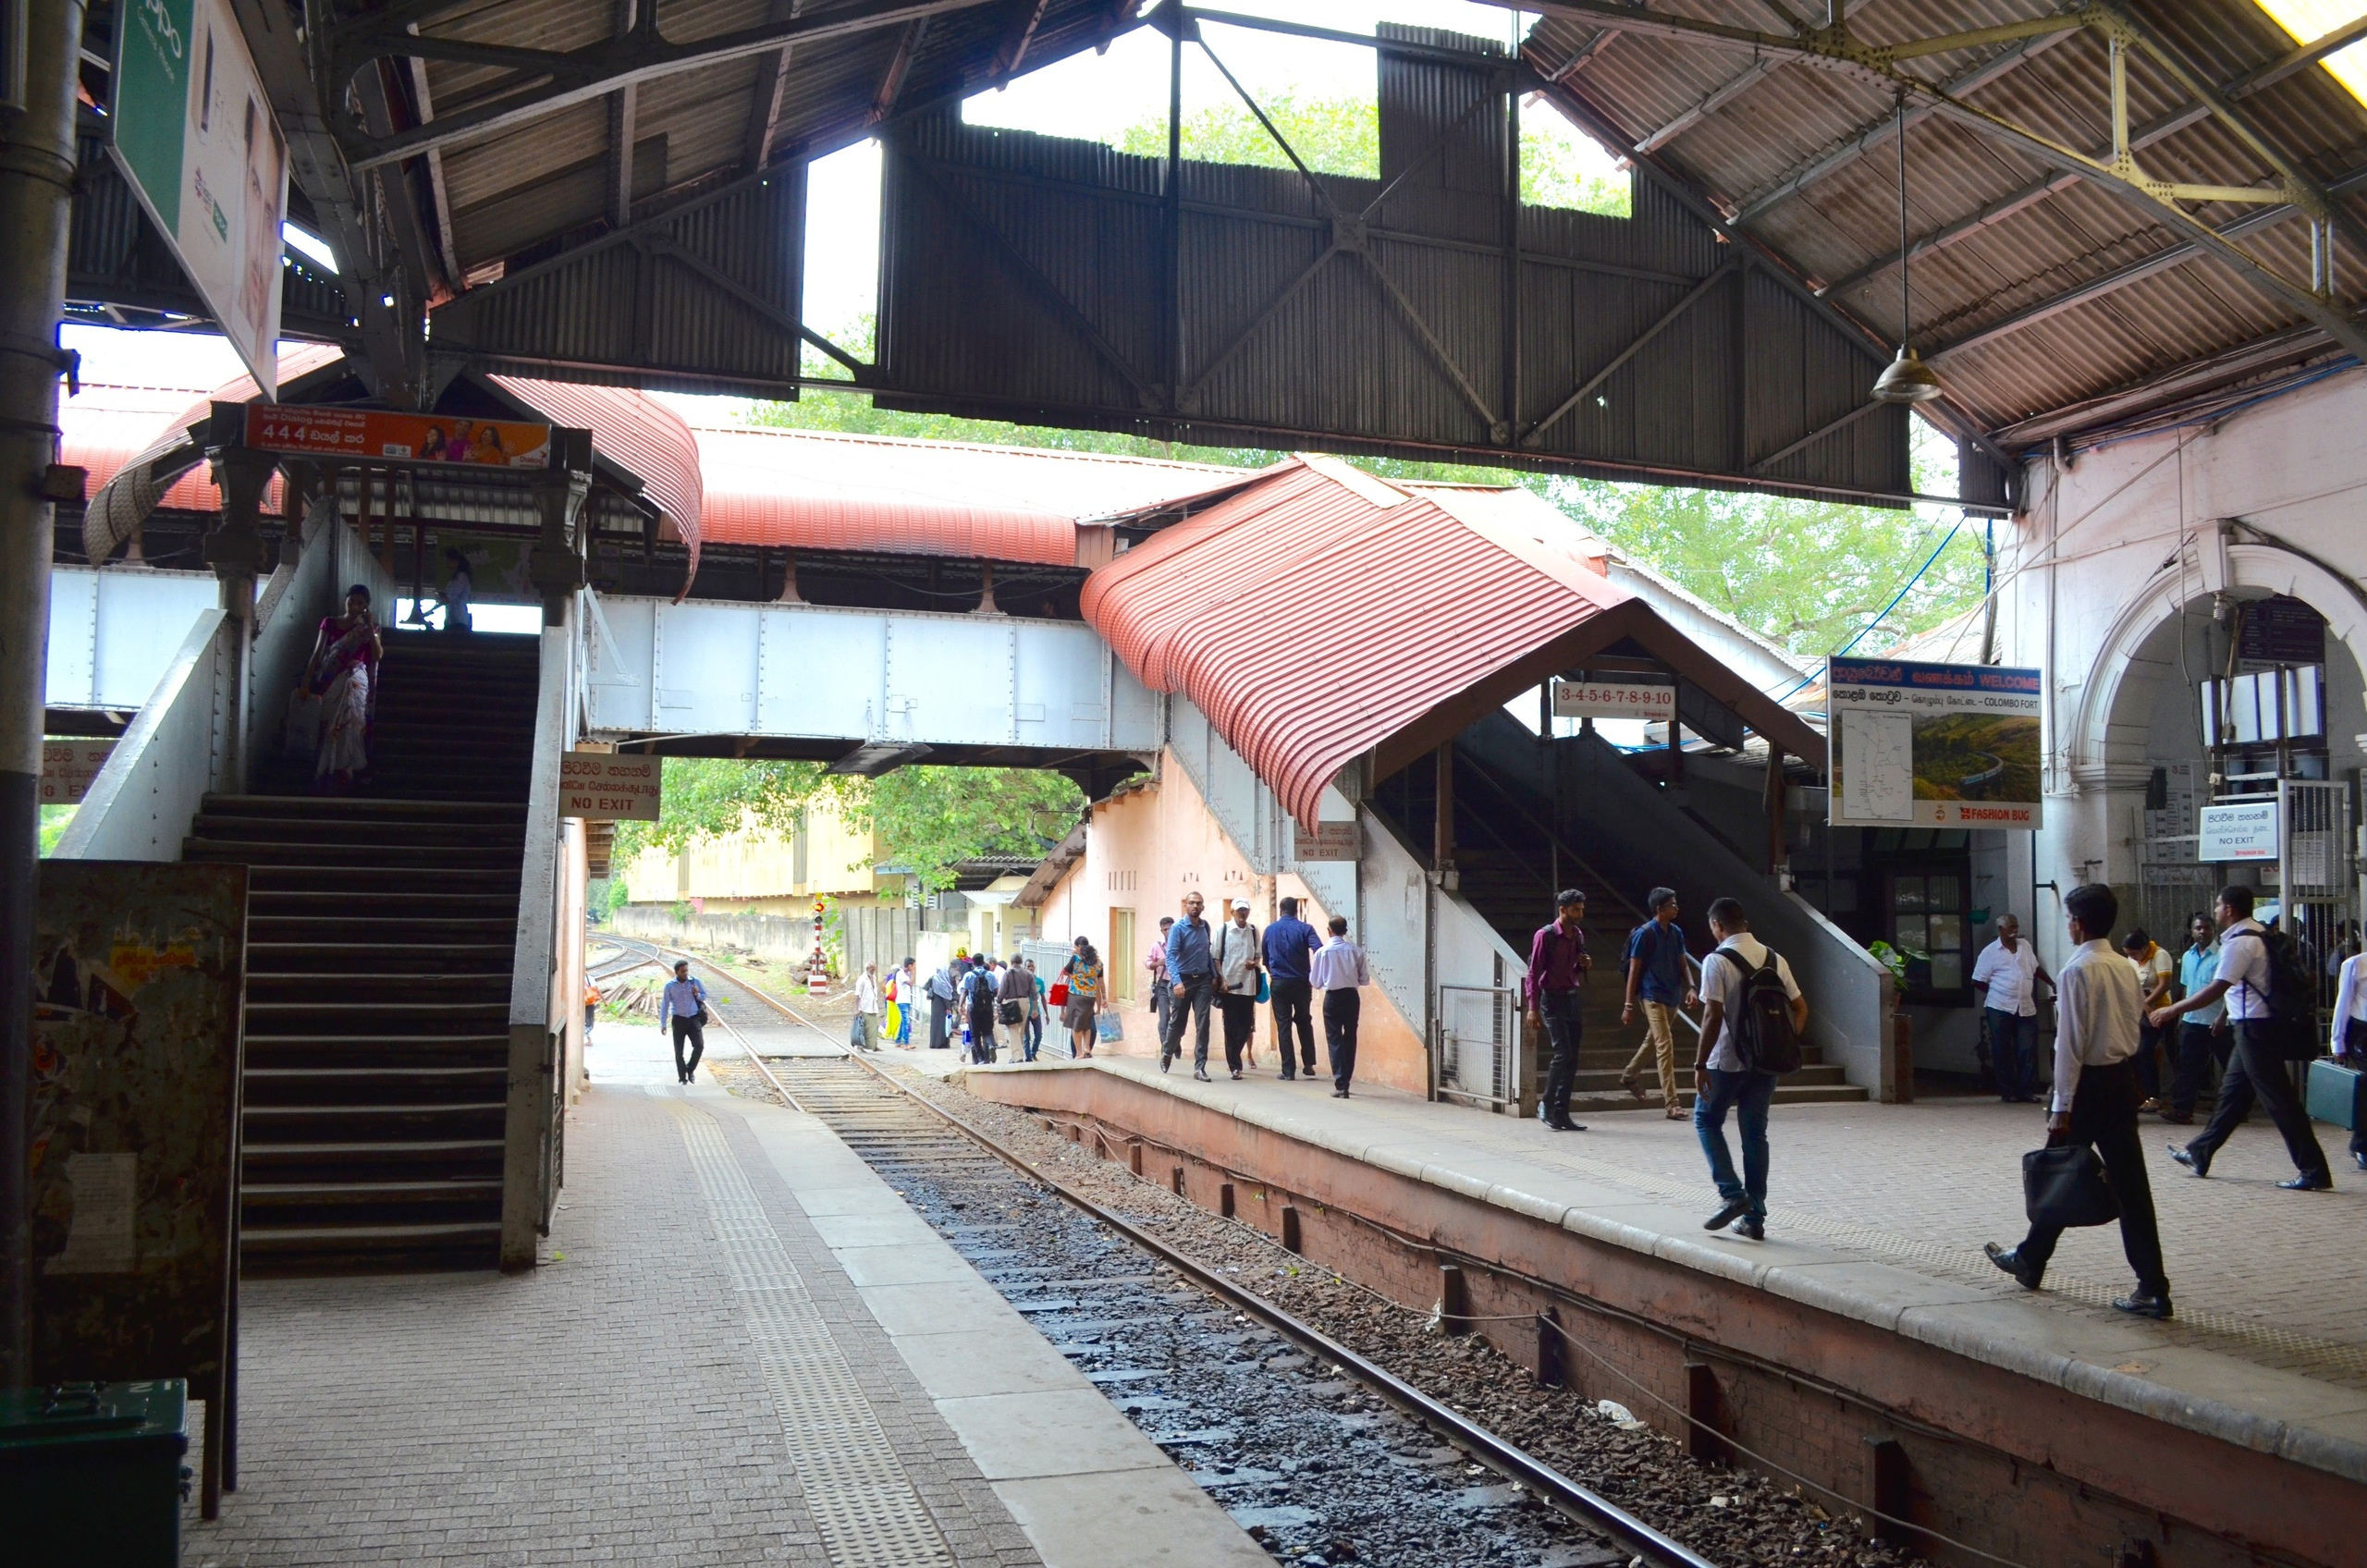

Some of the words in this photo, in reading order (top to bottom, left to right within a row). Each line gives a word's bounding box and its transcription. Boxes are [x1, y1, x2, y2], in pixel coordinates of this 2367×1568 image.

[280, 413, 313, 425] Dialog
[1912, 670, 1974, 685] வணக்கம்
[1980, 673, 2041, 691] WELCOME
[1562, 688, 1672, 704] 3-4-5-6-7-8-9-10
[1984, 697, 2019, 708] COLOMBO
[2020, 700, 2039, 709] FORT
[43, 747, 74, 763] ටවීම
[570, 797, 592, 810] NO
[599, 798, 634, 811] EXIT
[1971, 807, 2010, 821] FASHION
[2012, 809, 2030, 821] BUG
[2219, 837, 2234, 845] NO
[2235, 836, 2255, 844] EXIT
[1302, 849, 1314, 857] NO
[1319, 848, 1339, 857] EXIT
